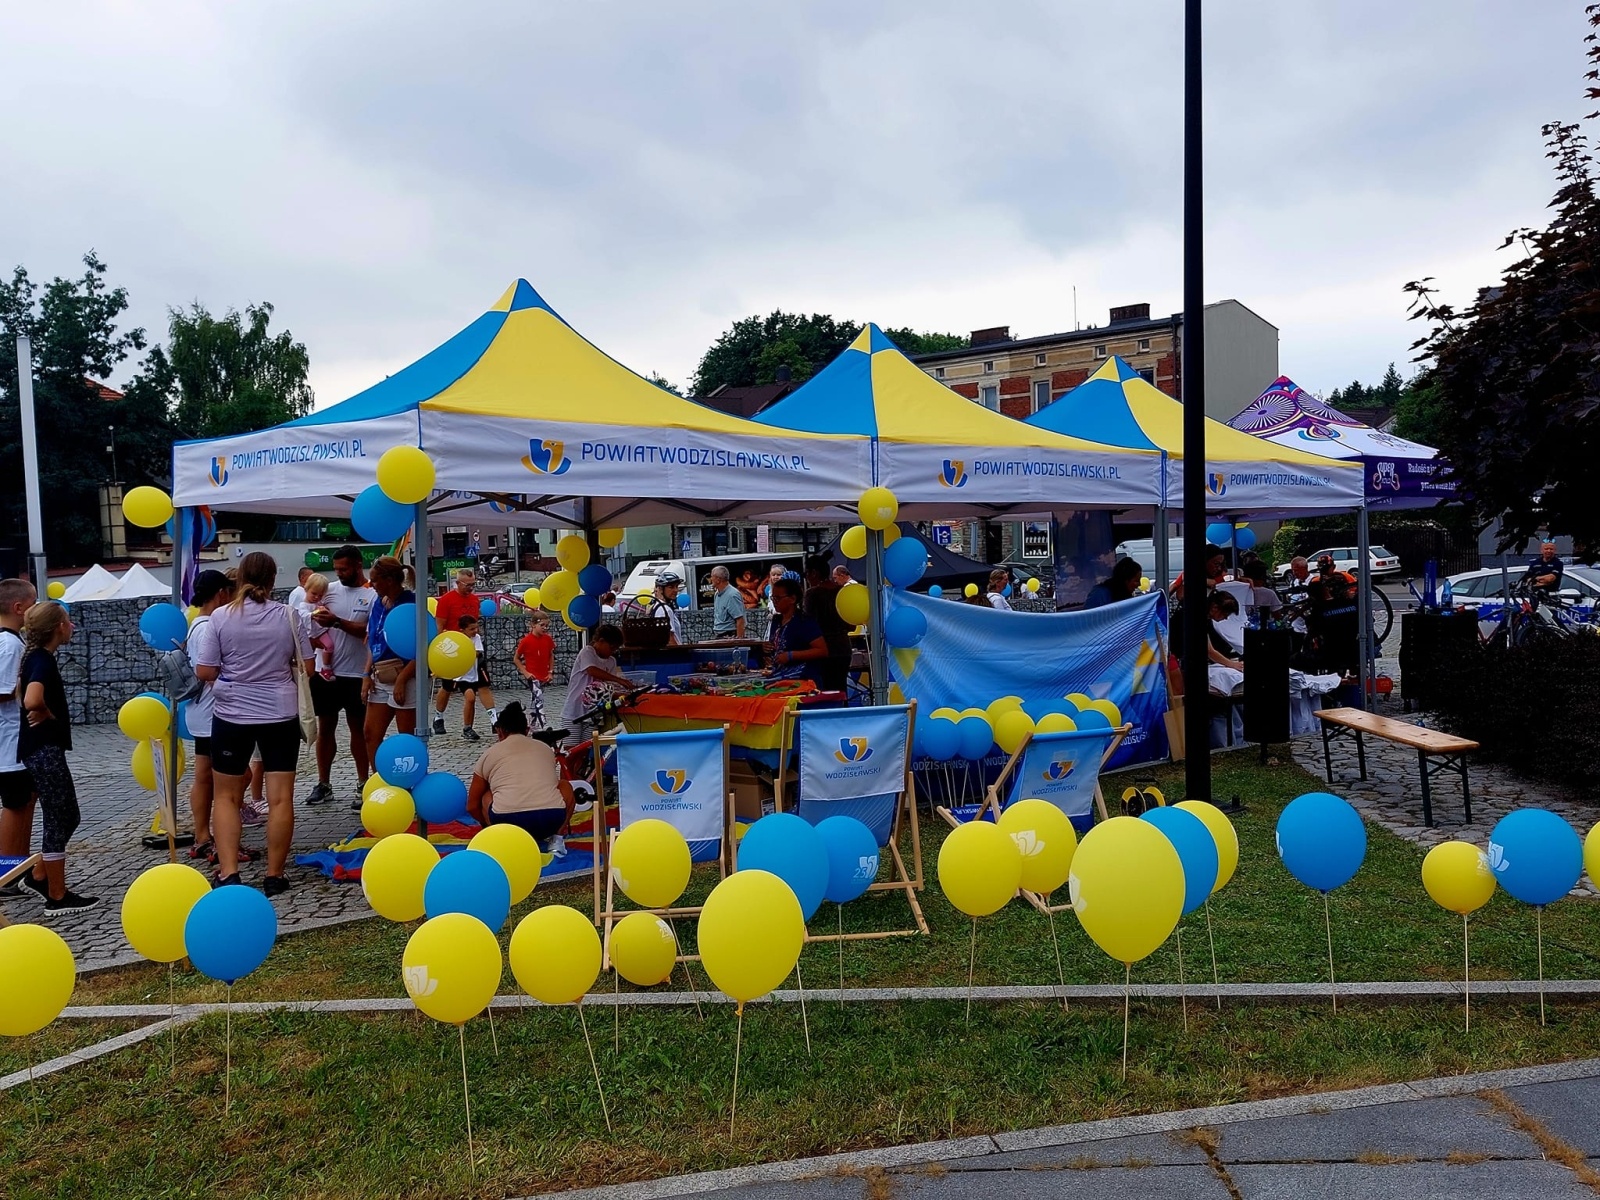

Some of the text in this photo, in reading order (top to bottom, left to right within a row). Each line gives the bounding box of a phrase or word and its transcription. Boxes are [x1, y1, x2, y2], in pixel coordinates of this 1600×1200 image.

[232, 439, 366, 470] POWIATWODZISLAWSKI.PL
[582, 442, 810, 471] POWIATWODZISLAWSKI.PL
[974, 461, 1121, 479] POWIATWODZISLAWSKI.PL
[641, 803, 702, 811] WODZISŁAWSKI
